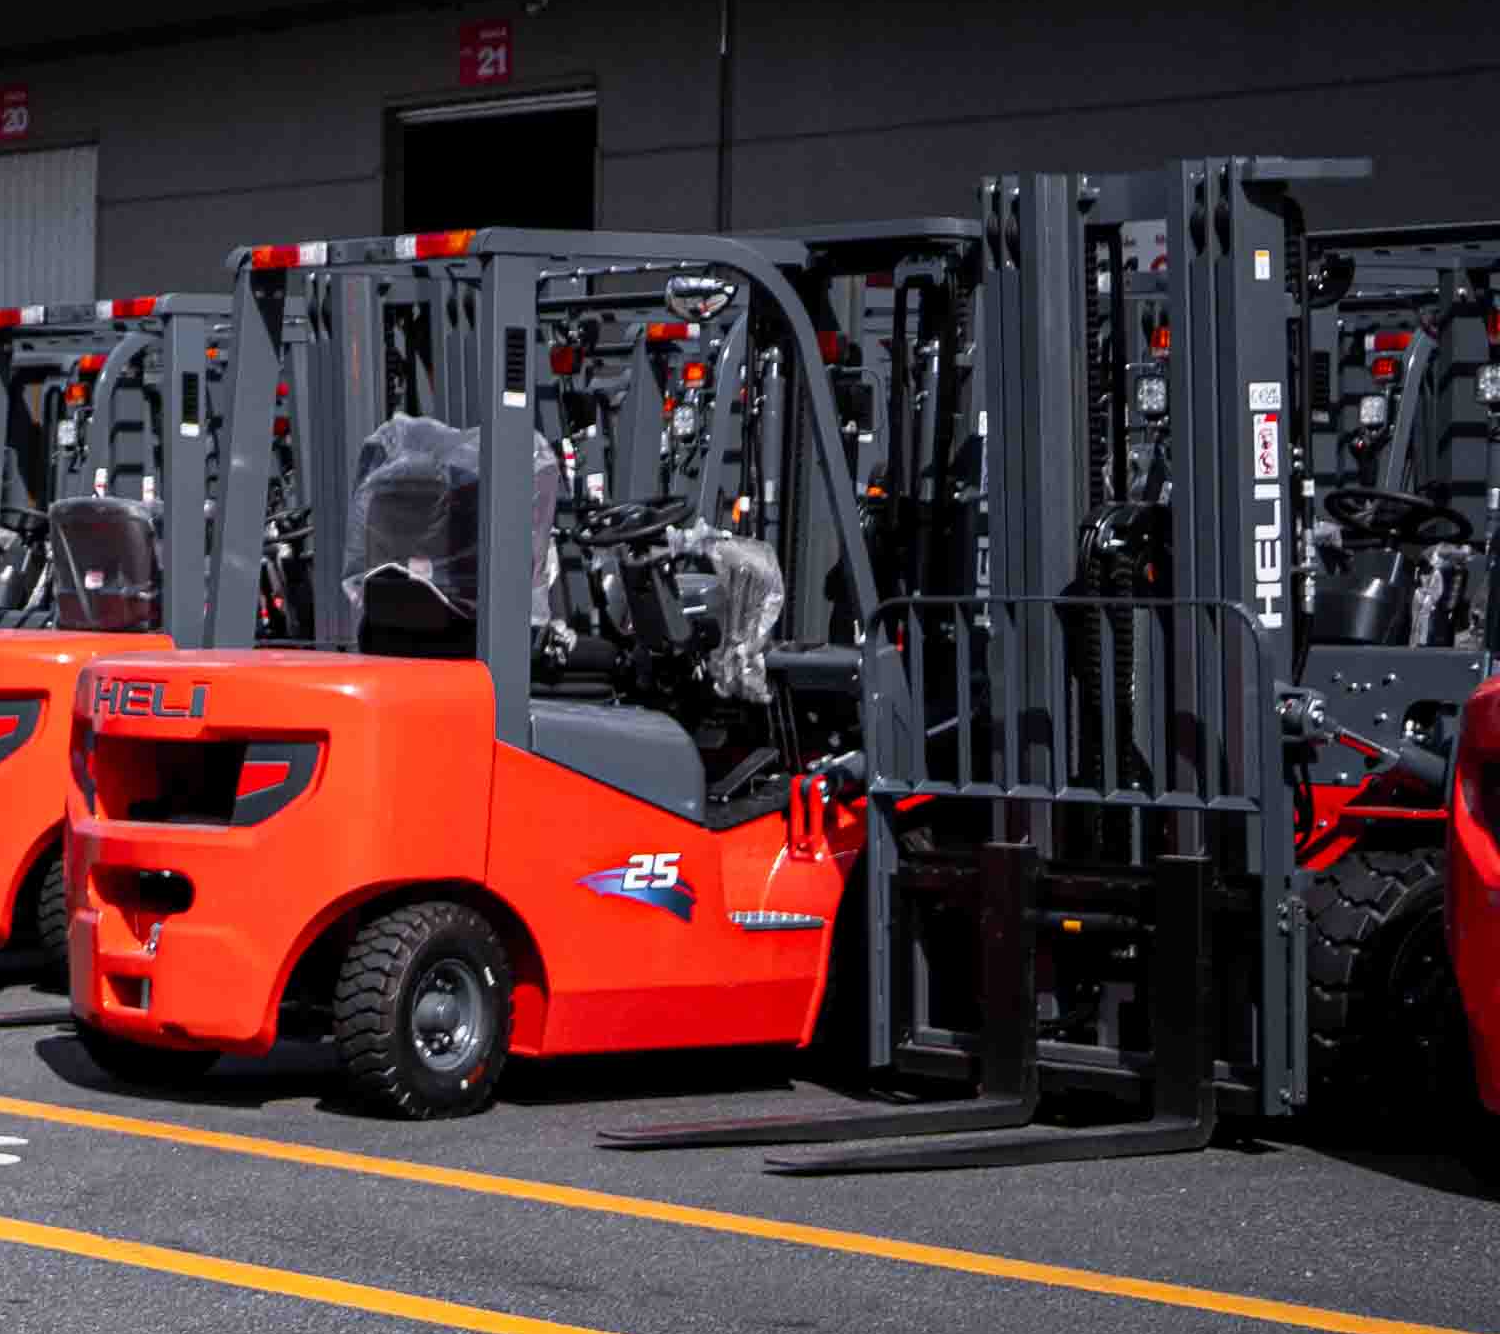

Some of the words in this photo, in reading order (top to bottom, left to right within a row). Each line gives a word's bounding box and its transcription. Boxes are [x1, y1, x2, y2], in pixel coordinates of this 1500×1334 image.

[478, 44, 508, 75] 21
[2, 107, 29, 132] 20
[1253, 483, 1283, 628] HELI
[94, 677, 208, 719] HELI
[622, 852, 682, 890] 25
